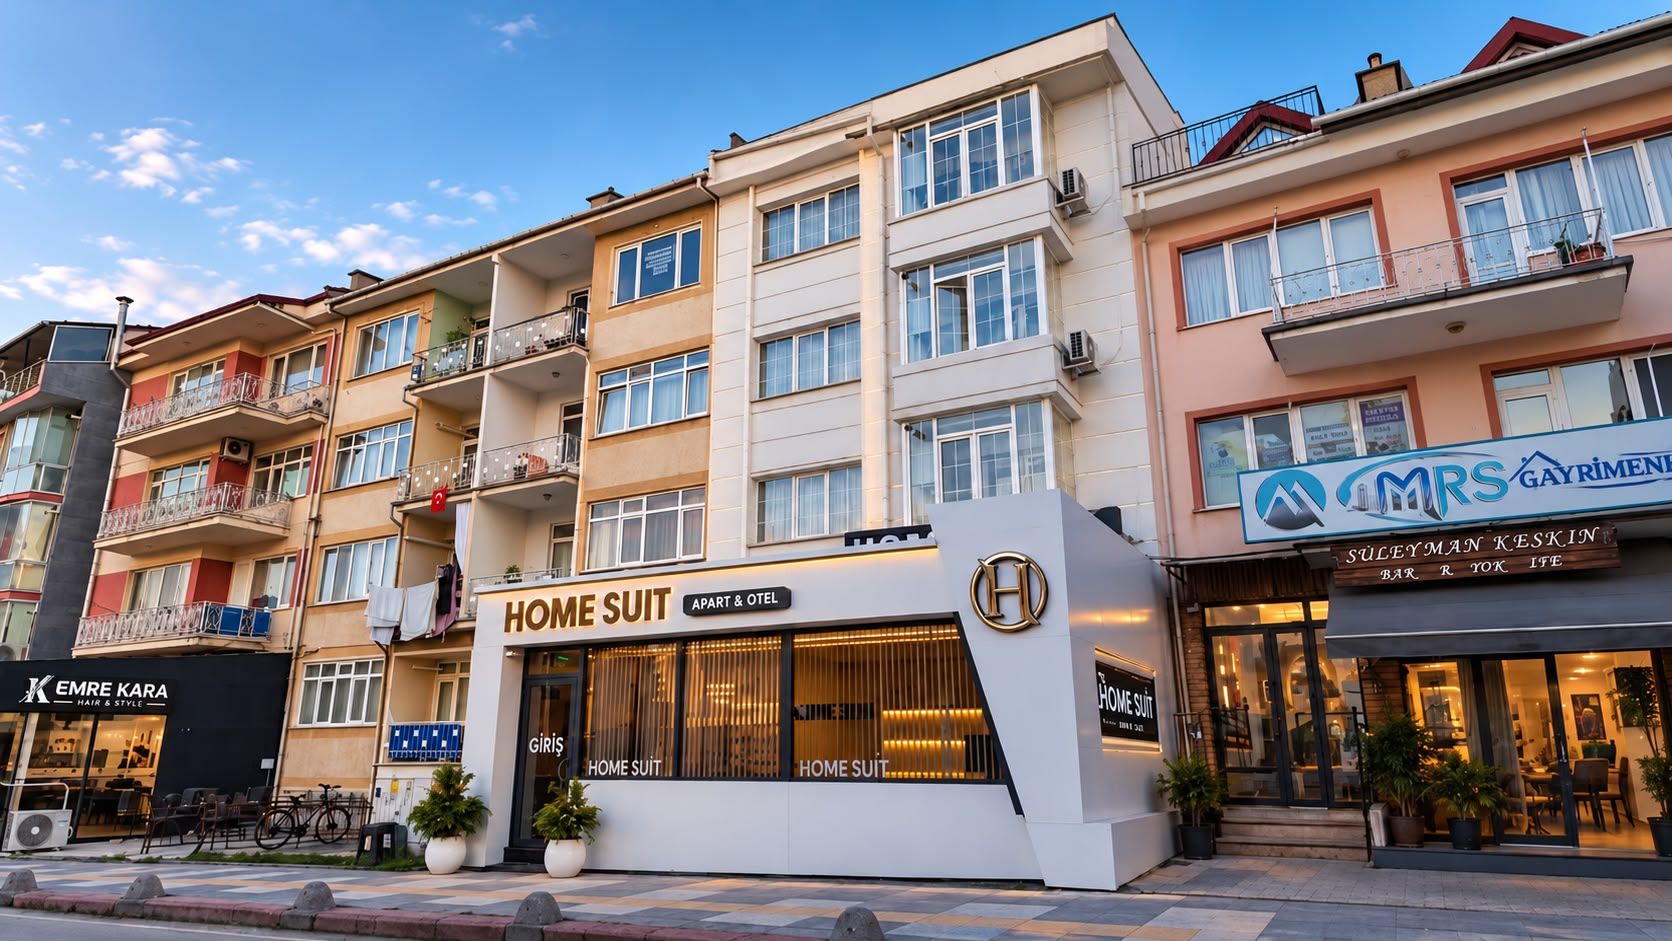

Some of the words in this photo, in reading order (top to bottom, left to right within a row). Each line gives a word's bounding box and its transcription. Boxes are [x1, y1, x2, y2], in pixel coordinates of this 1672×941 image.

[1376, 461, 1510, 521] MRS
[1345, 536, 1484, 564] SÜLEYMAN
[1493, 526, 1600, 553] KESKIN
[1380, 567, 1419, 580] BAR
[504, 593, 596, 633] HOME
[602, 587, 672, 624] SUIT
[691, 596, 731, 611] APART
[734, 595, 743, 607] &
[746, 591, 779, 606] OTEL
[55, 680, 113, 697] EMRE
[116, 682, 169, 699] KARA
[1098, 683, 1133, 715] HOME
[77, 699, 101, 707] HAIR
[114, 700, 143, 708] STYLE
[528, 732, 564, 757] GİRİŞ
[588, 760, 628, 776] HOME
[631, 755, 662, 776] SUİT
[799, 760, 848, 778] HOME
[851, 752, 890, 778] SUİT
